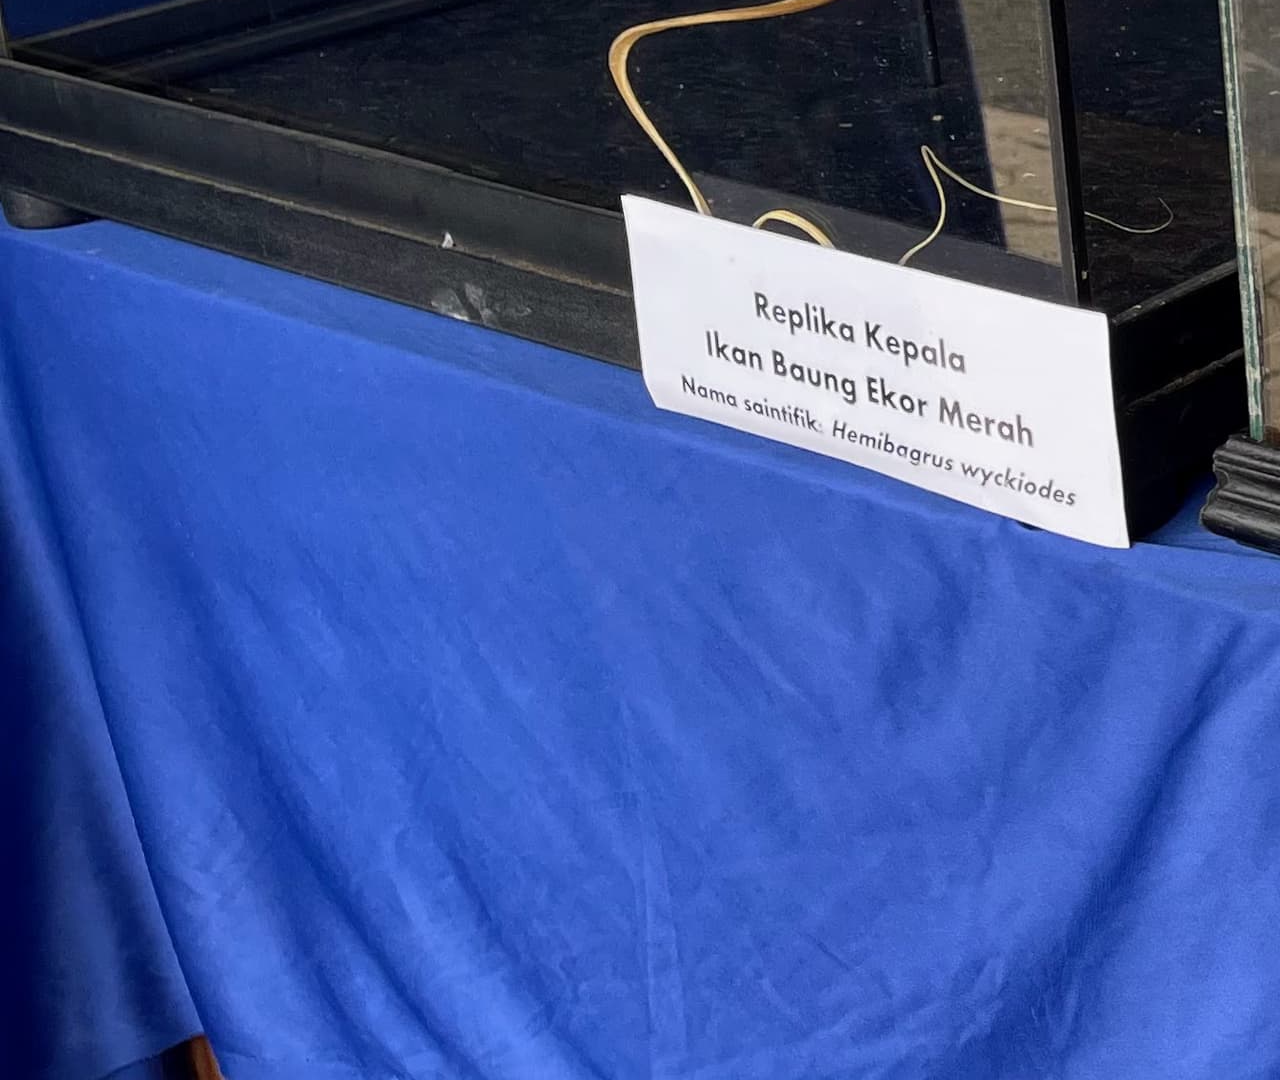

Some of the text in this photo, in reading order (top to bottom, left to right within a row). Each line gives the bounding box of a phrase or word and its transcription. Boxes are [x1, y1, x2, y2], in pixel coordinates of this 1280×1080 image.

[706, 331, 1034, 448] Ikan Baung Ekor Merah
[754, 291, 966, 375] Replika Kepala
[682, 374, 1077, 508] Nama saintifik: Hemibagrus wyckiodes
